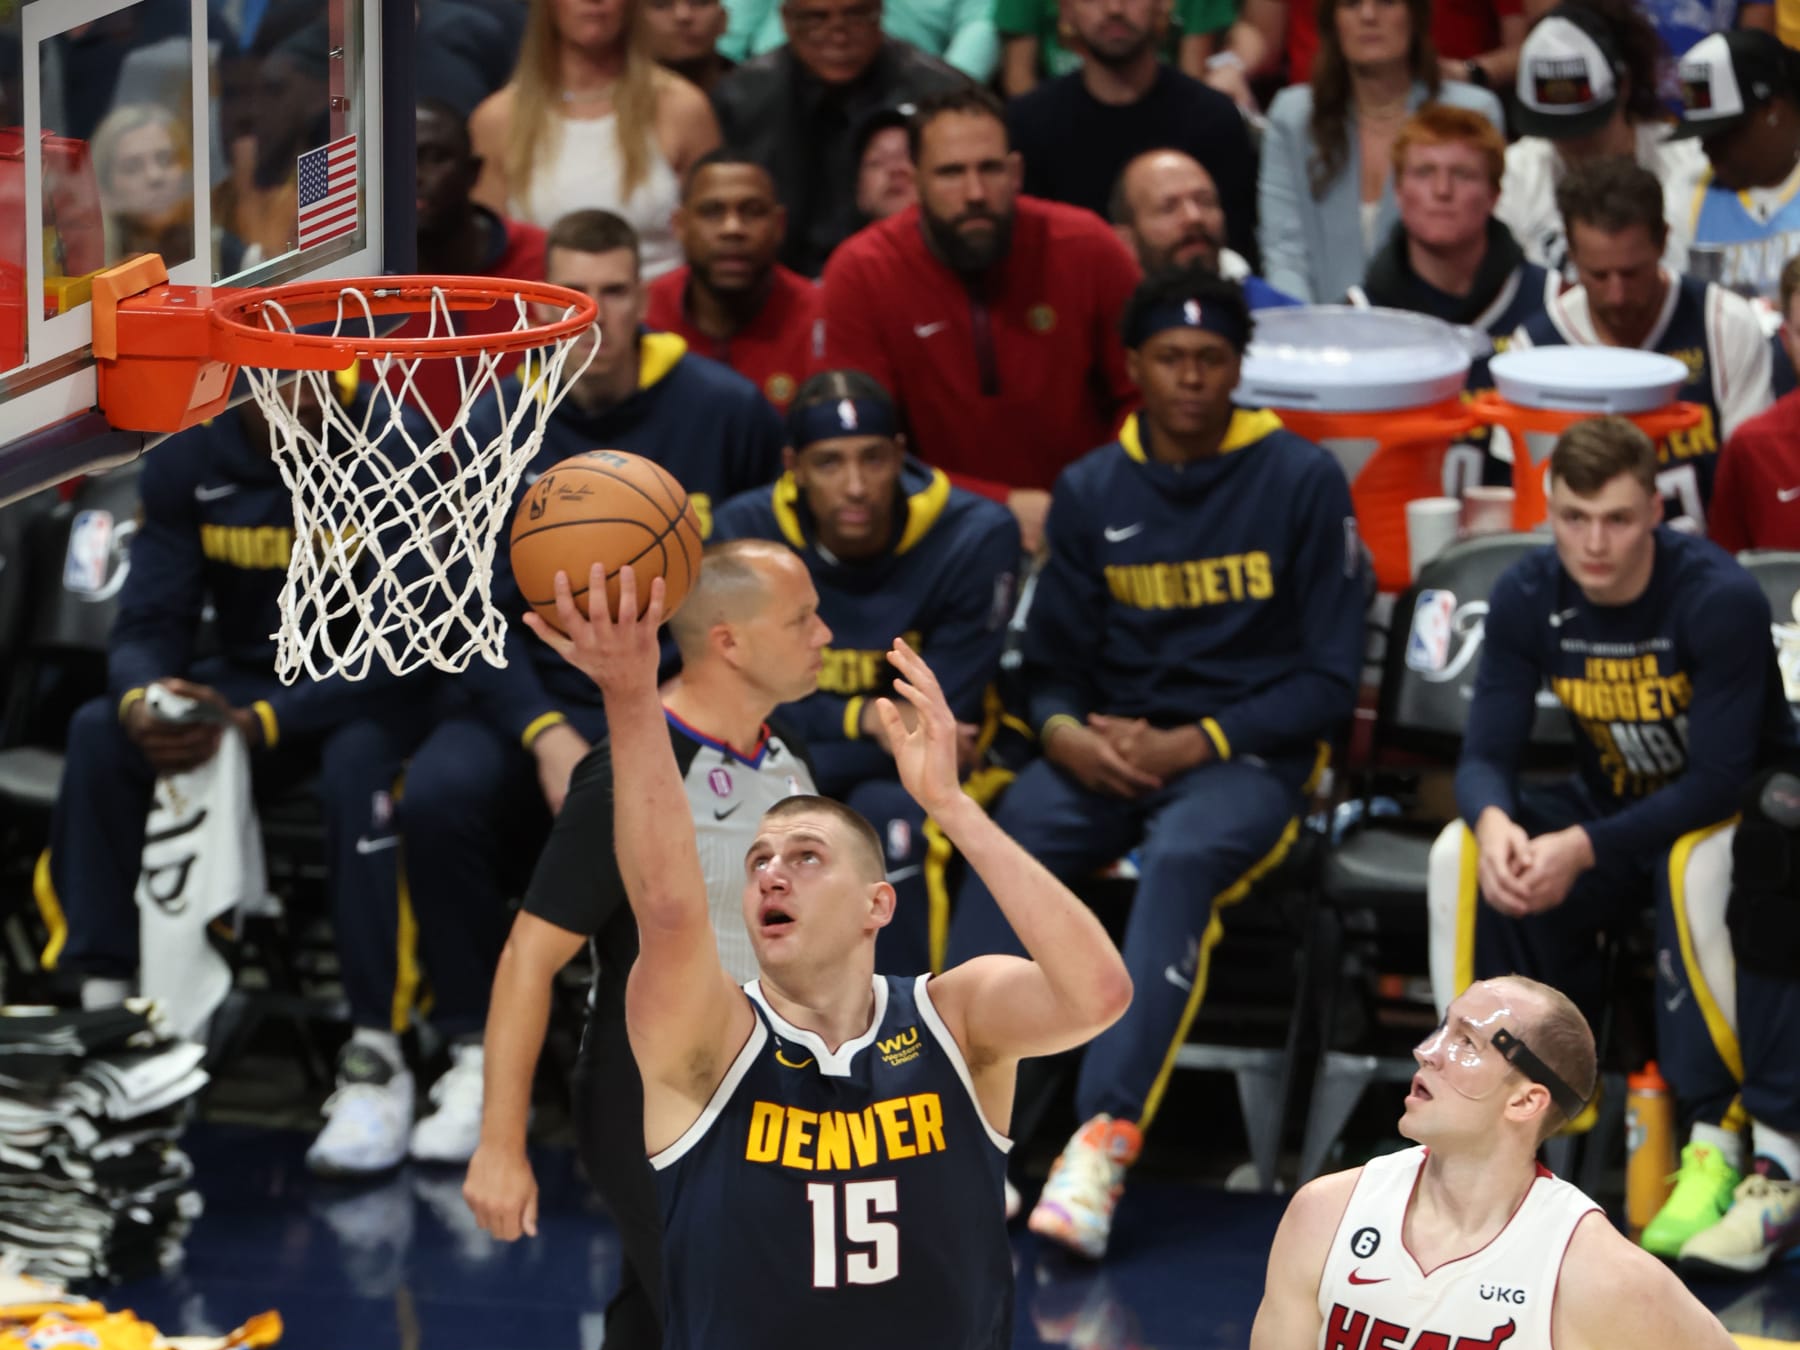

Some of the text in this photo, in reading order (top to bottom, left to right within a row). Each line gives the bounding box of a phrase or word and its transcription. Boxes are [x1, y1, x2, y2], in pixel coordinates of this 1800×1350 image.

[1104, 550, 1274, 612] NUGGETS
[1552, 671, 1694, 723] NUGGETS
[1609, 714, 1690, 776] NB
[876, 1026, 918, 1054] WU
[882, 1042, 922, 1062] Western
[891, 1052, 919, 1066] Union
[745, 1092, 947, 1171] DENVER
[806, 1177, 900, 1289] 15
[1354, 1230, 1378, 1257] 6
